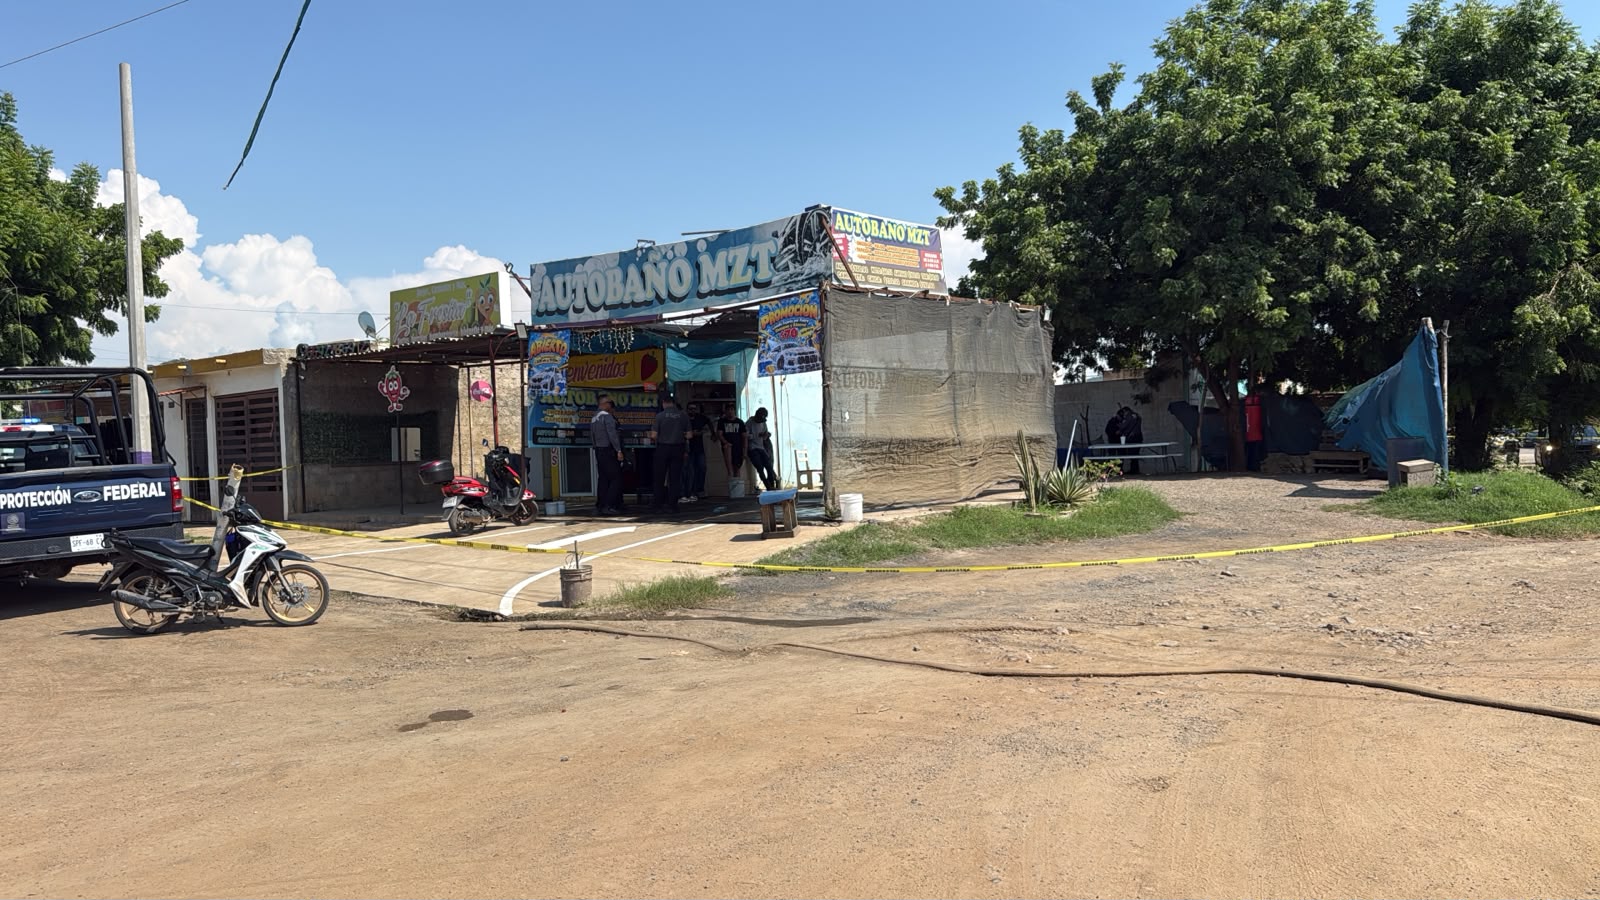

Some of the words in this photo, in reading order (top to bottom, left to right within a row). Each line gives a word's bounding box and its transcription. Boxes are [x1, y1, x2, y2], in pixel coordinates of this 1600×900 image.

[907, 226, 931, 246] MZT
[537, 251, 693, 314] AUTOBAÑO
[698, 239, 779, 296] MZT
[0, 486, 72, 510] PROTECCIÓN
[103, 482, 166, 502] FEDERAL
